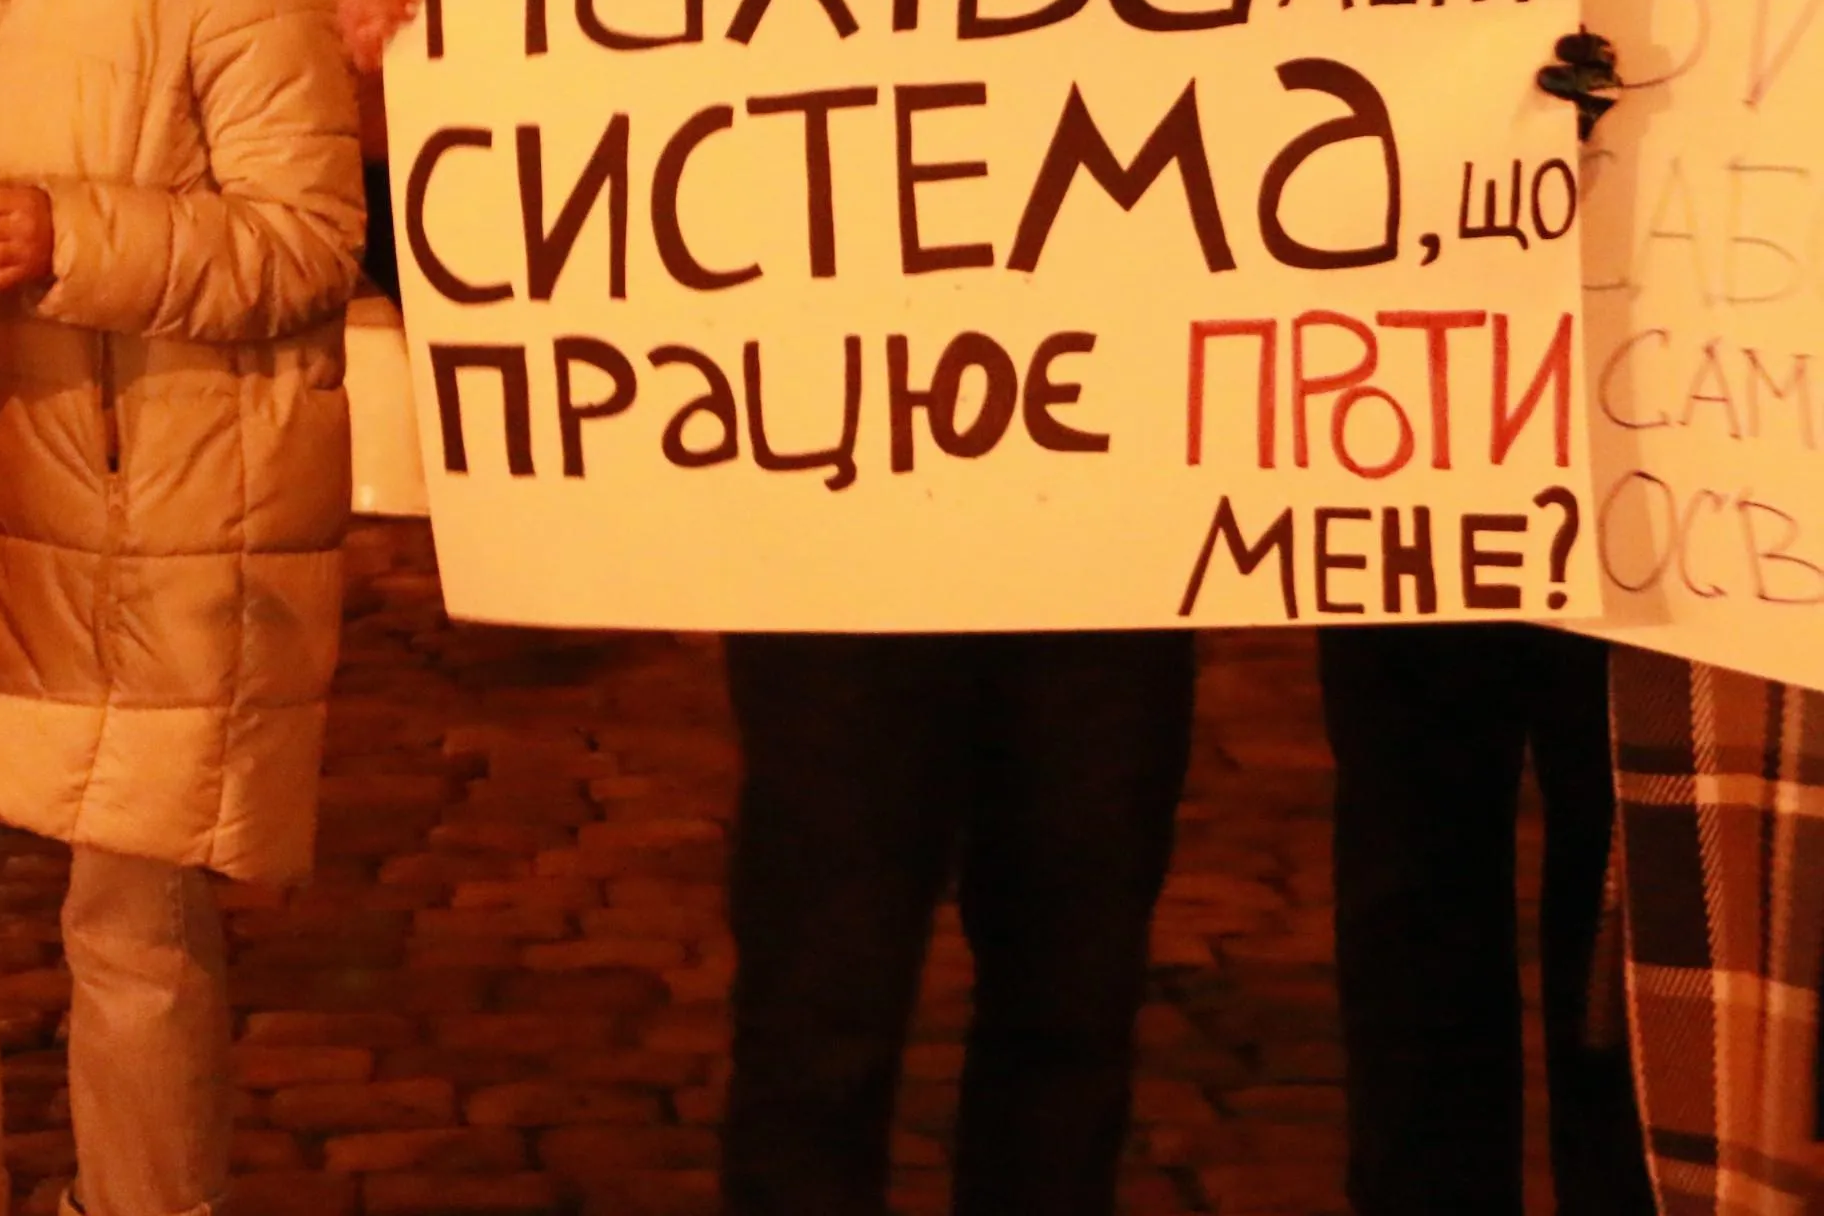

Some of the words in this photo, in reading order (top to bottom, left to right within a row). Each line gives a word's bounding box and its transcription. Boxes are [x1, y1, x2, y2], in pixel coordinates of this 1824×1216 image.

[1458, 159, 1576, 250] ЩО
[1186, 309, 1574, 479] ПРОТИ
[1178, 486, 1579, 619] МЕНЕ?
